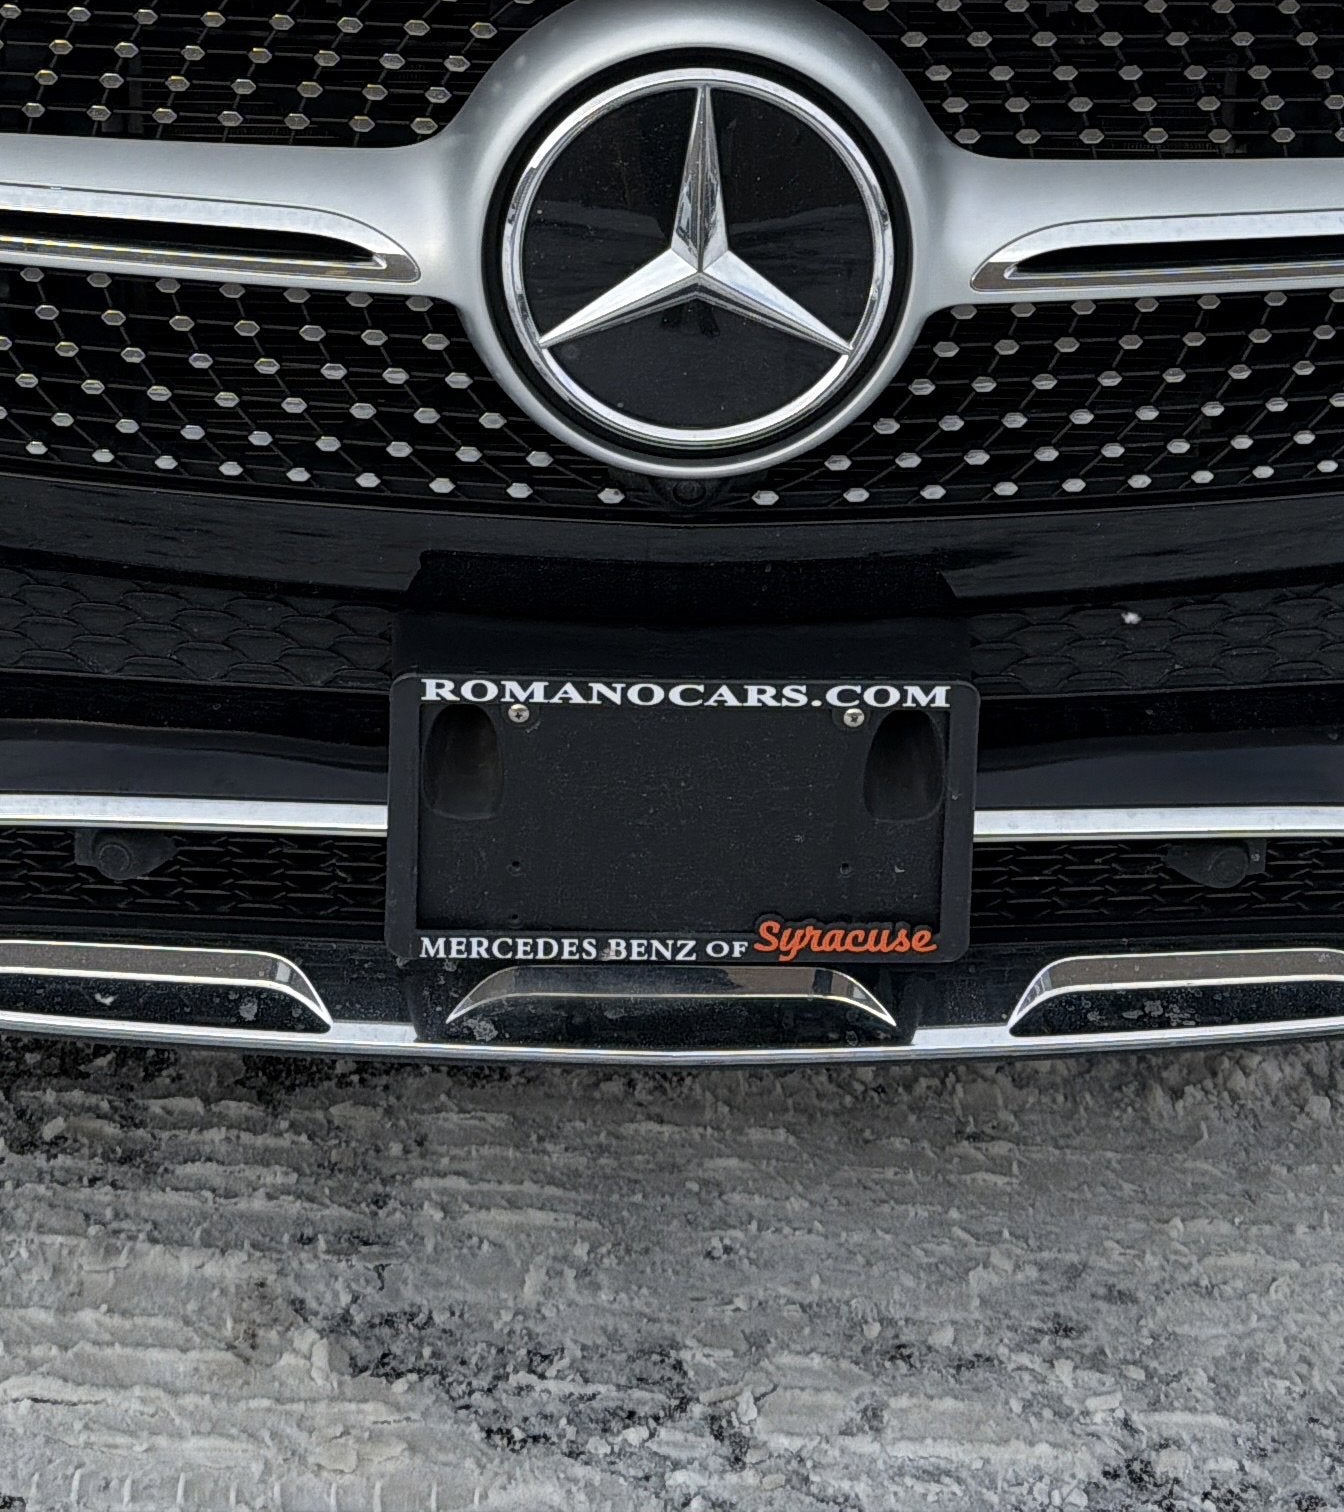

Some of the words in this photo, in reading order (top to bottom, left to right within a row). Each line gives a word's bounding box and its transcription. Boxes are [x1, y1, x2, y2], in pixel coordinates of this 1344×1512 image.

[420, 678, 952, 708] ROMANOCARS.COM
[418, 936, 598, 960] MERCEDES
[608, 938, 697, 961] BENZ
[705, 940, 749, 958] OF
[753, 919, 939, 963] Syracuse
